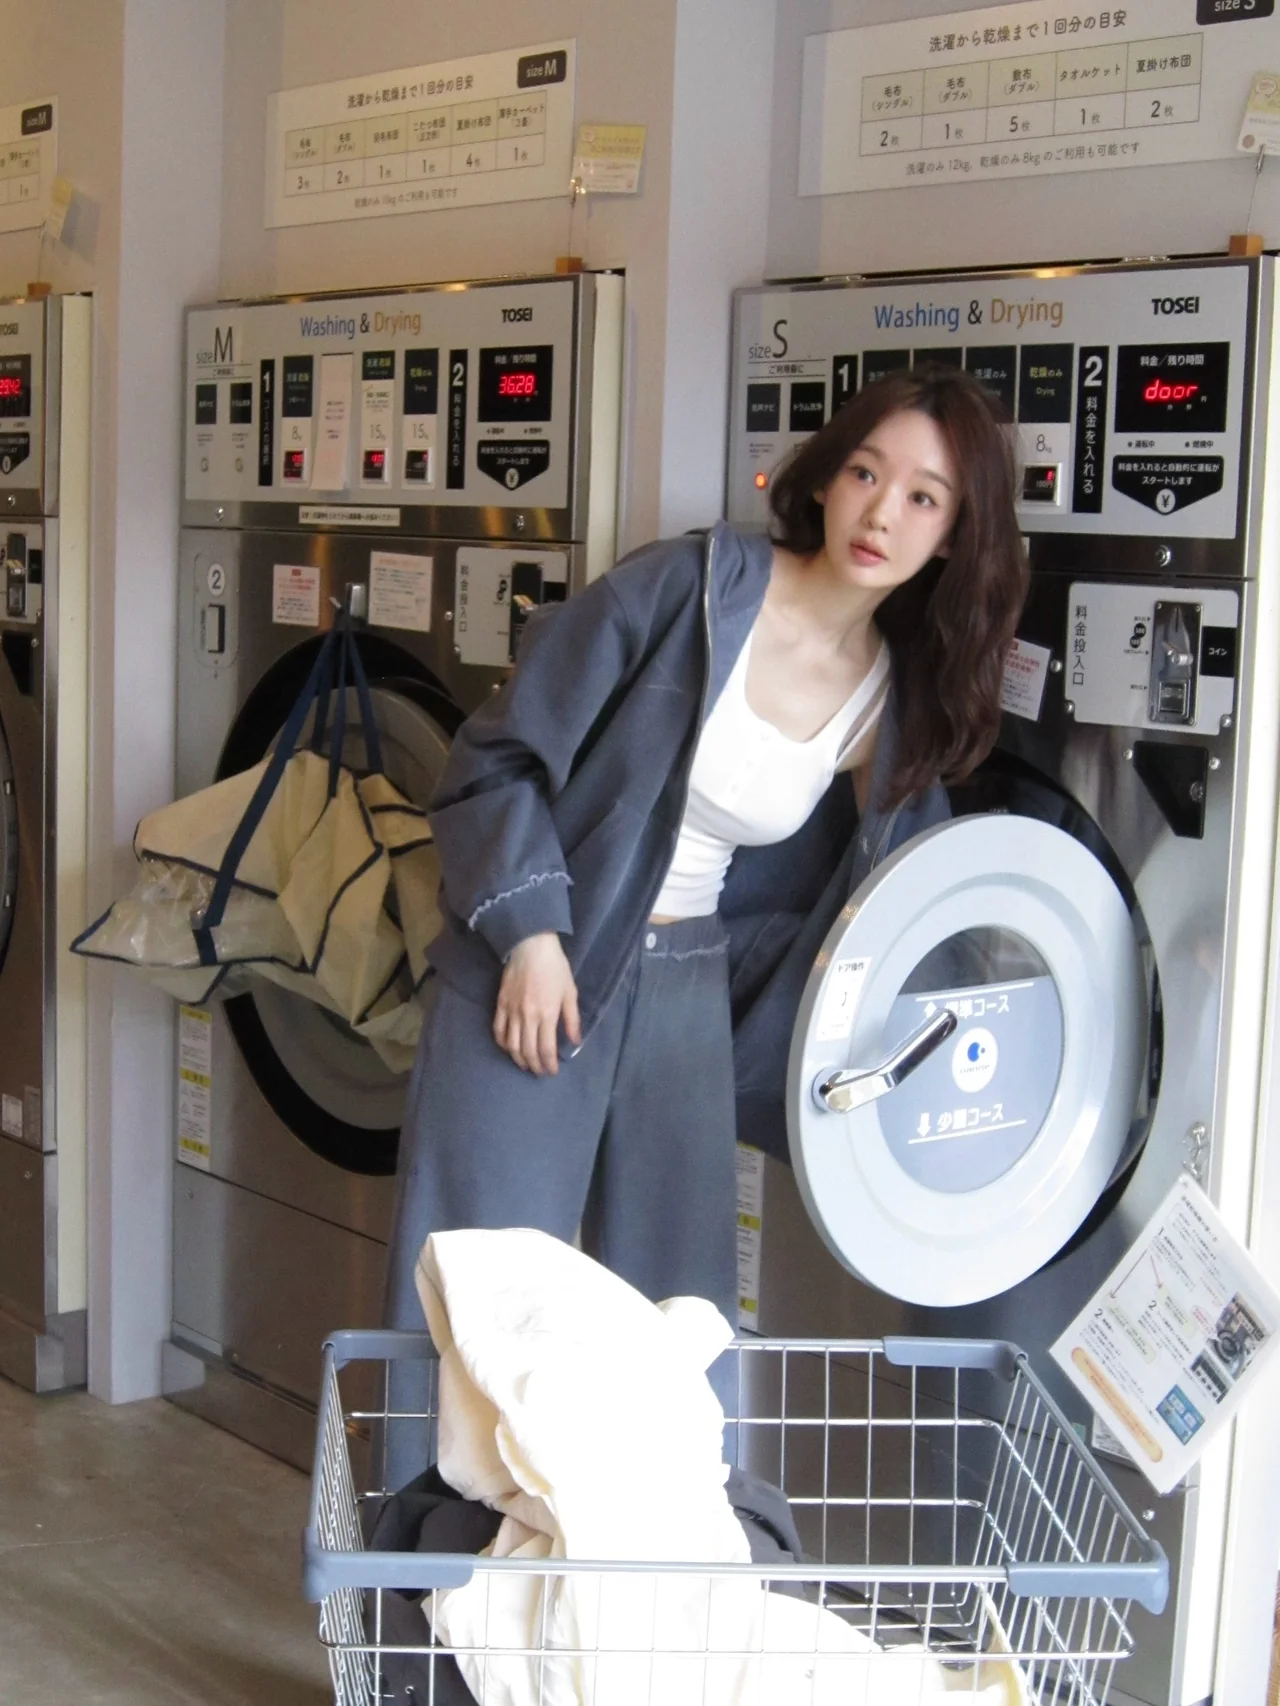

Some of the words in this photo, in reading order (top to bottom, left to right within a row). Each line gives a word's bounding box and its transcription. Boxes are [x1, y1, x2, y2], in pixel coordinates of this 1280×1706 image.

[1059, 64, 1121, 82] タオルケット
[501, 307, 533, 323] TOSEI
[874, 302, 960, 333] Washing
[967, 299, 983, 325] &
[990, 296, 1063, 329] Drying
[1151, 296, 1200, 316] TOSEI
[300, 314, 356, 340] Washing
[360, 312, 369, 334] &
[374, 309, 421, 338] Drying
[771, 318, 788, 359] S
[1029, 366, 1063, 378] 乾燥のみ
[1083, 355, 1104, 388] 2
[1144, 379, 1199, 401] door
[1083, 396, 1099, 495] 料金を入れる
[1142, 477, 1193, 486] スタートします
[1072, 604, 1088, 687] 料金投入口
